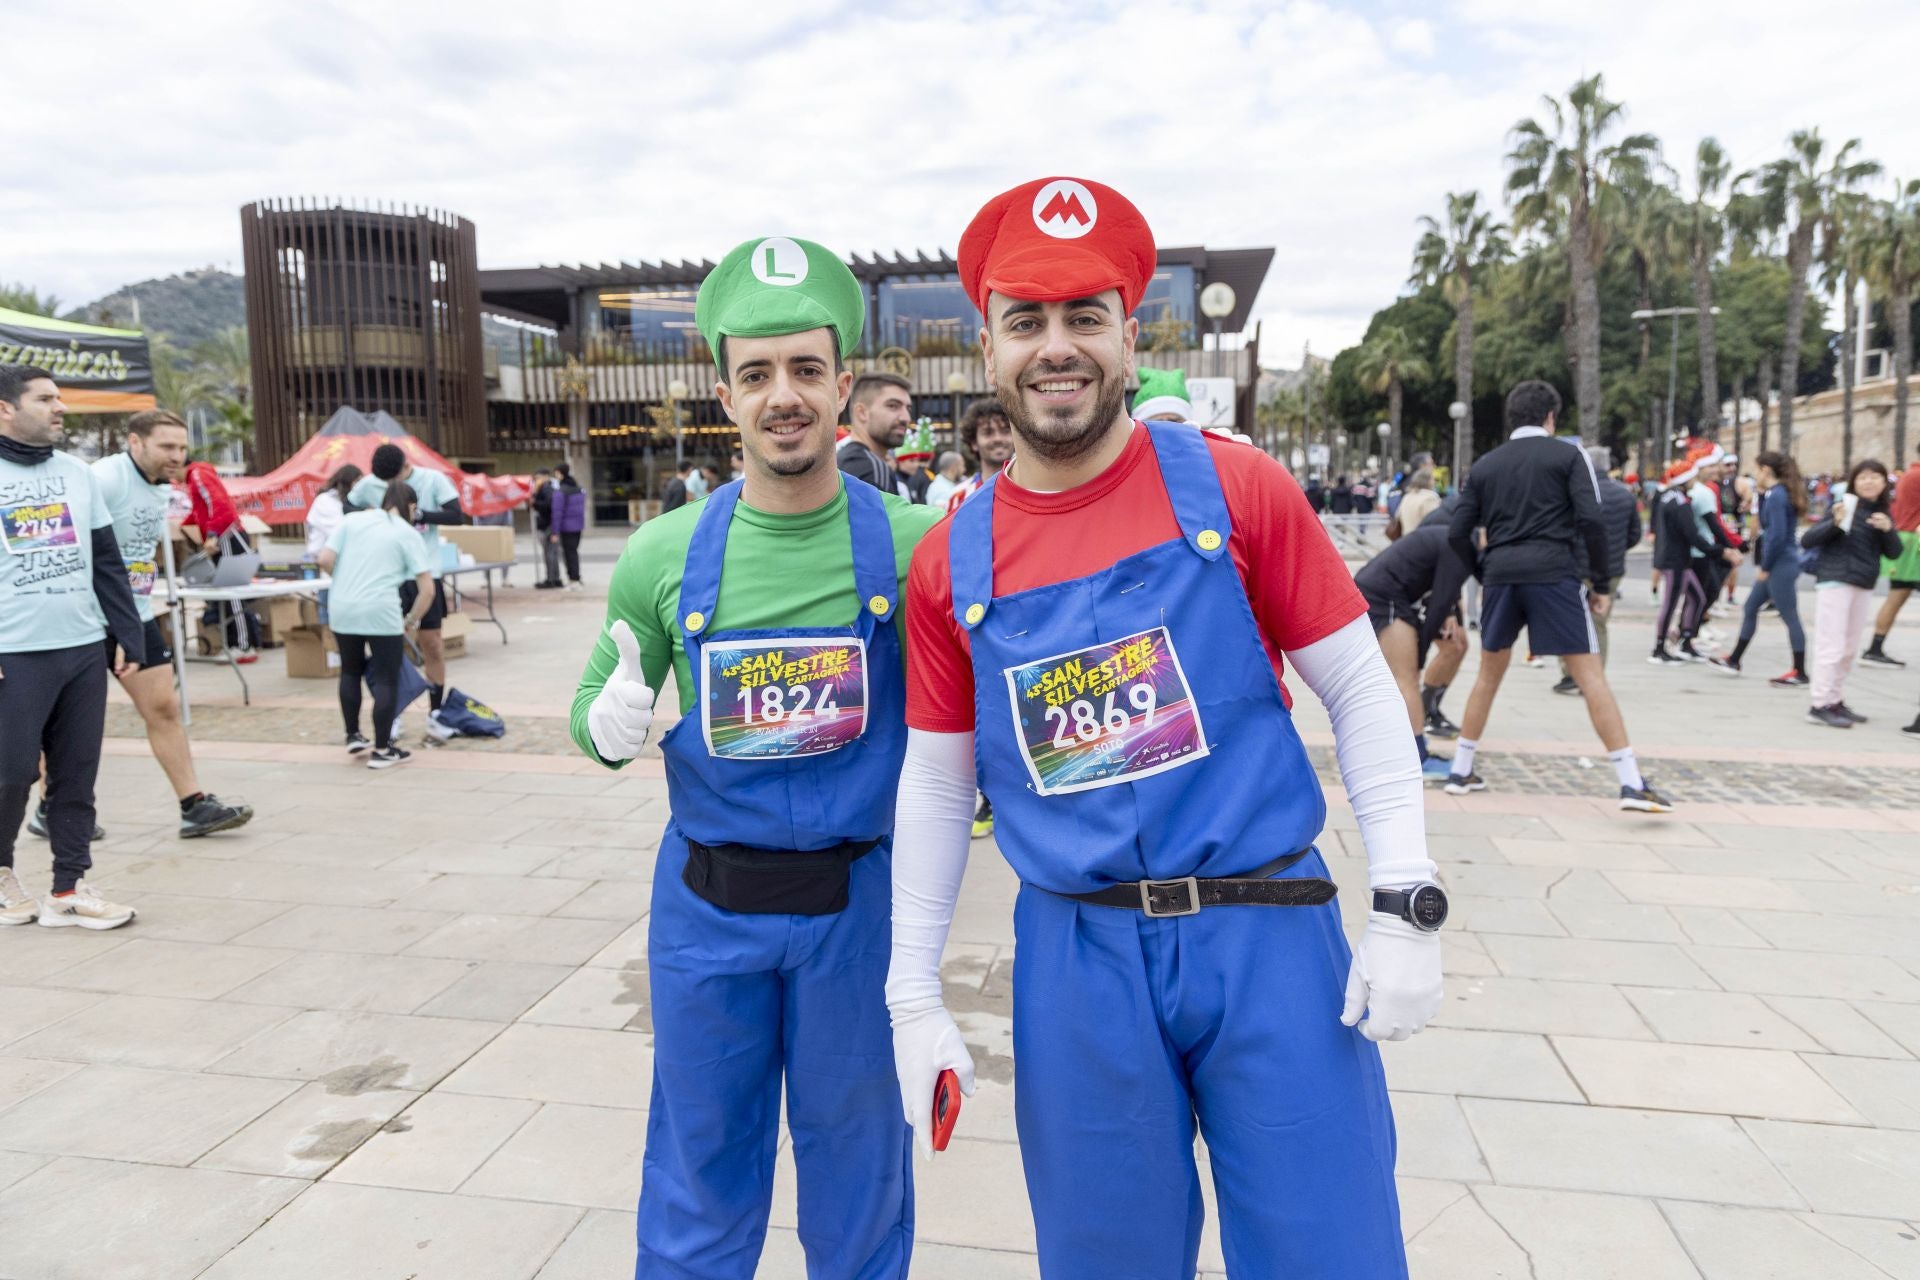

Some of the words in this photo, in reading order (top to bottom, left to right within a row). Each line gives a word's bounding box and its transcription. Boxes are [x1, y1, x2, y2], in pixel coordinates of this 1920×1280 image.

[1038, 190, 1091, 226] M
[765, 247, 796, 278] L
[0, 476, 66, 505] SAN
[14, 516, 63, 538] 2767
[740, 650, 784, 674] SAN
[740, 648, 849, 690] SILVESTRE
[786, 664, 850, 687] CARTAGENA
[1041, 657, 1082, 693] SAN
[1044, 636, 1156, 709] SILVESTRE
[1093, 655, 1158, 698] CARTAGENA
[737, 683, 840, 724] 1824
[1044, 682, 1157, 749] 2869
[782, 725, 818, 736] MRIN
[1093, 738, 1124, 755] SOTO
